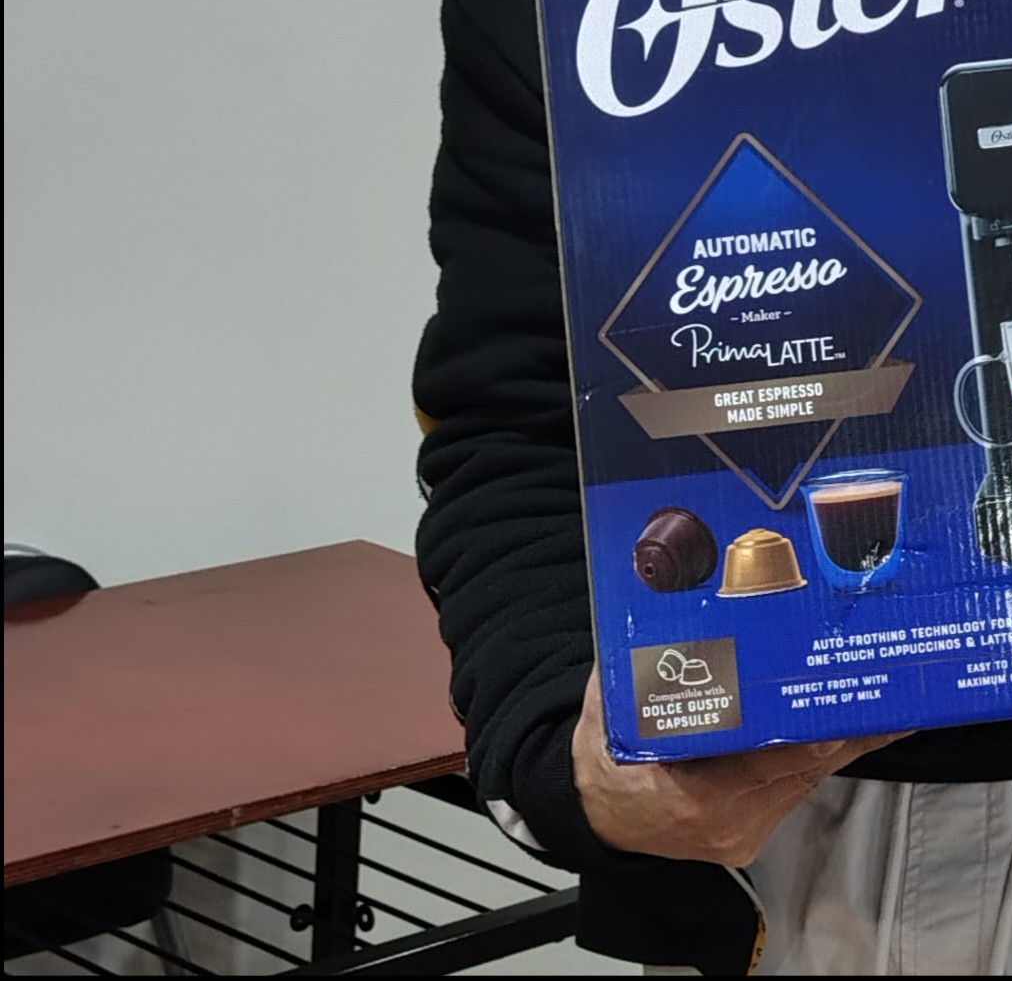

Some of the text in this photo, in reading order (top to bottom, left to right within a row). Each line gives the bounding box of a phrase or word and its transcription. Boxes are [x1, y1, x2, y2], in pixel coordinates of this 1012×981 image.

[692, 227, 817, 259] AUTOMATIC
[669, 258, 848, 315] Espresso
[714, 382, 824, 407] GREAT ESPRESSO
[727, 401, 814, 424] MADE SIMPLE
[813, 617, 1012, 651] AUTO-FROTHING TECHNOLOGY FOR
[807, 650, 875, 667] ONE-TOUCH
[879, 638, 961, 659] CAPPUCCINOS
[966, 636, 976, 648] &
[967, 661, 991, 673] EASY
[994, 659, 1009, 670] TO
[781, 673, 889, 696] PERFECT FROTH WITH
[957, 674, 1007, 689] MAXIMUM
[648, 685, 726, 703] Compatible with
[791, 689, 882, 709] ANY TYPE OF MILK
[642, 701, 683, 718] DOLCE
[656, 712, 720, 731] CAPSULES
